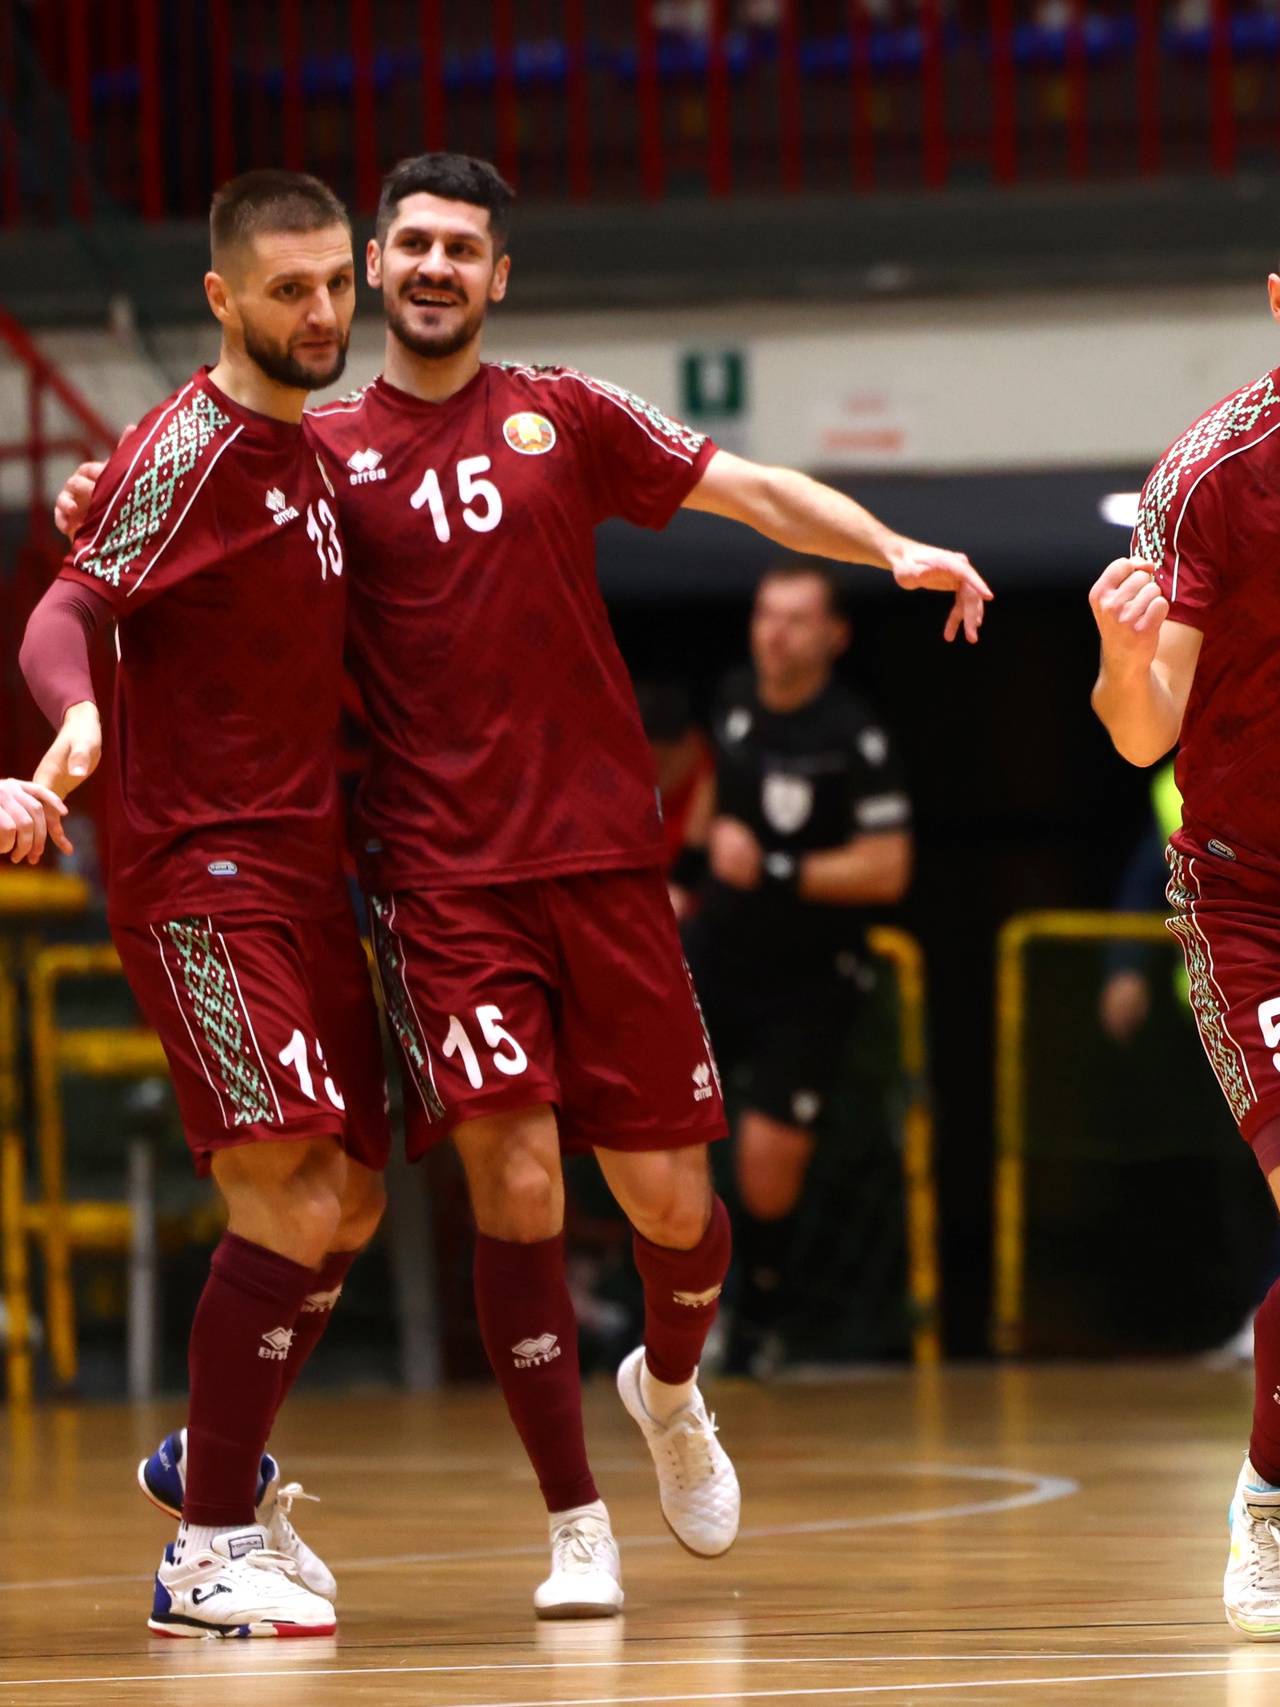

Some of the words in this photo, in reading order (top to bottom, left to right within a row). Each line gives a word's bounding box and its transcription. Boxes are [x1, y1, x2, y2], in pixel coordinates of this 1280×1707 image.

[349, 468, 387, 485] errea
[410, 454, 503, 543] 15
[306, 498, 343, 581] 13
[442, 1004, 528, 1090] 15
[513, 1345, 562, 1369] errea
